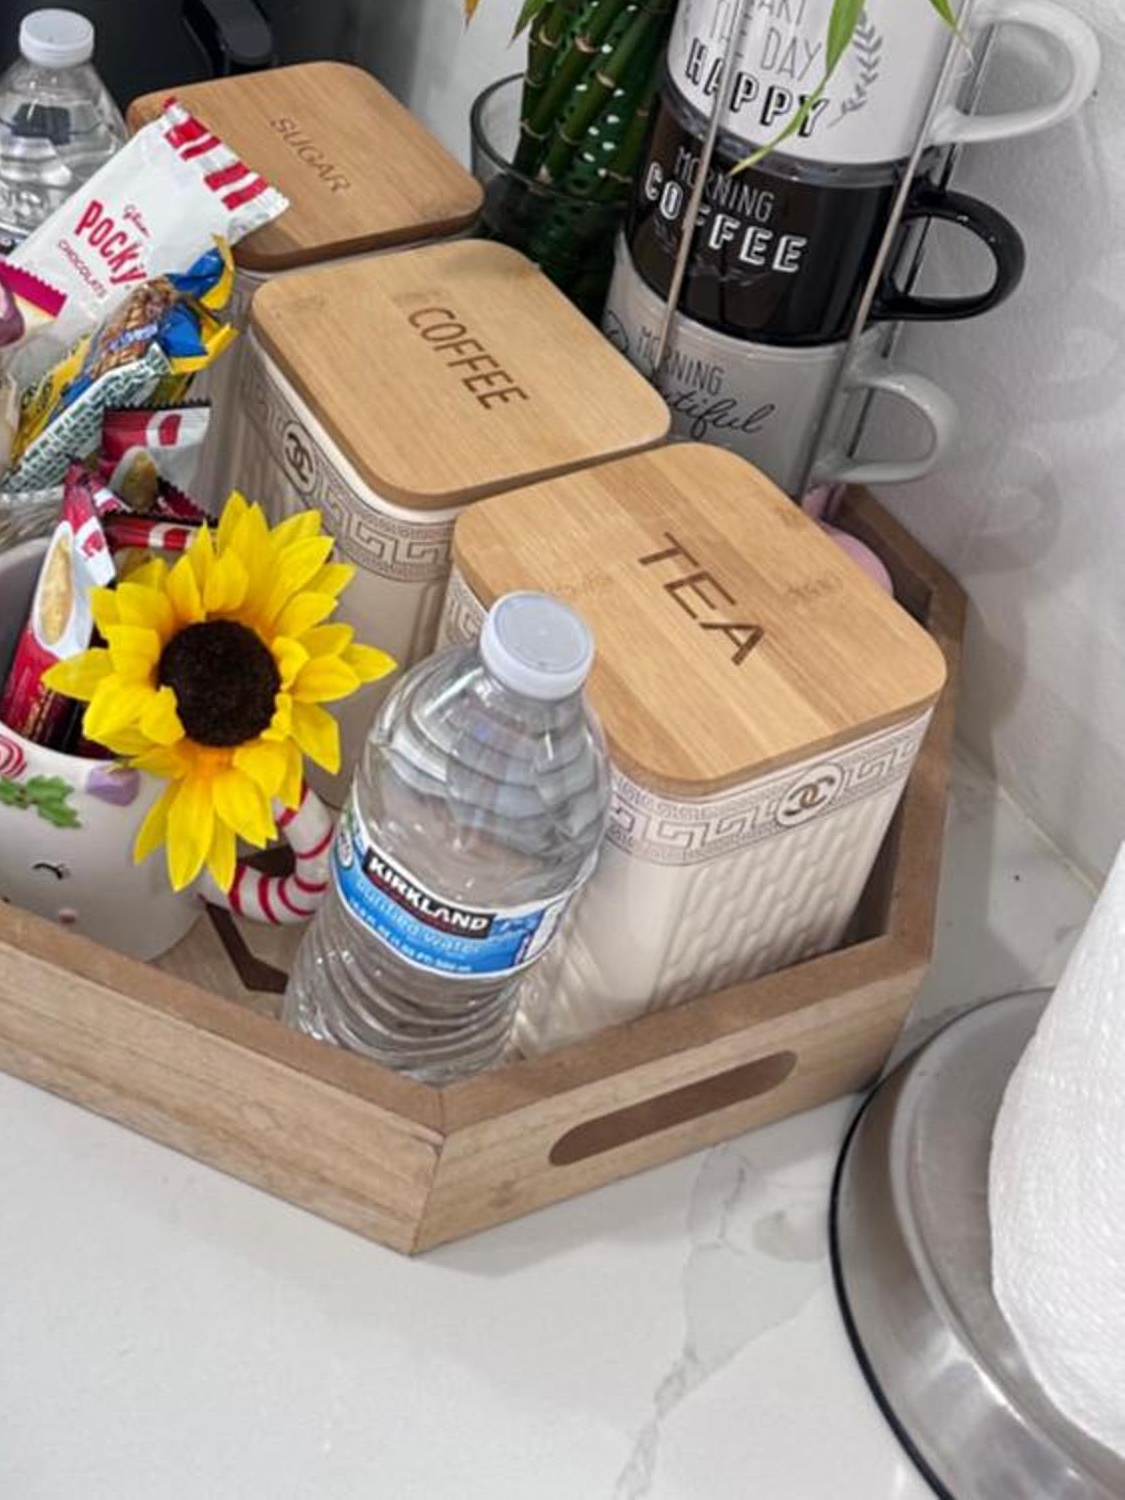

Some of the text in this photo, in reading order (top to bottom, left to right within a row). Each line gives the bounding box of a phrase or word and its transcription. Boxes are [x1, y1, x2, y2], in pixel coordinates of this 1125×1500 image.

[684, 37, 830, 138] HAPPY
[759, 26, 822, 82] DAY
[269, 116, 352, 195] SUGAR
[408, 306, 531, 411] COFFEE
[664, 389, 776, 441] tiful
[638, 532, 771, 668] TEA
[368, 855, 490, 933] KIRKLAND
